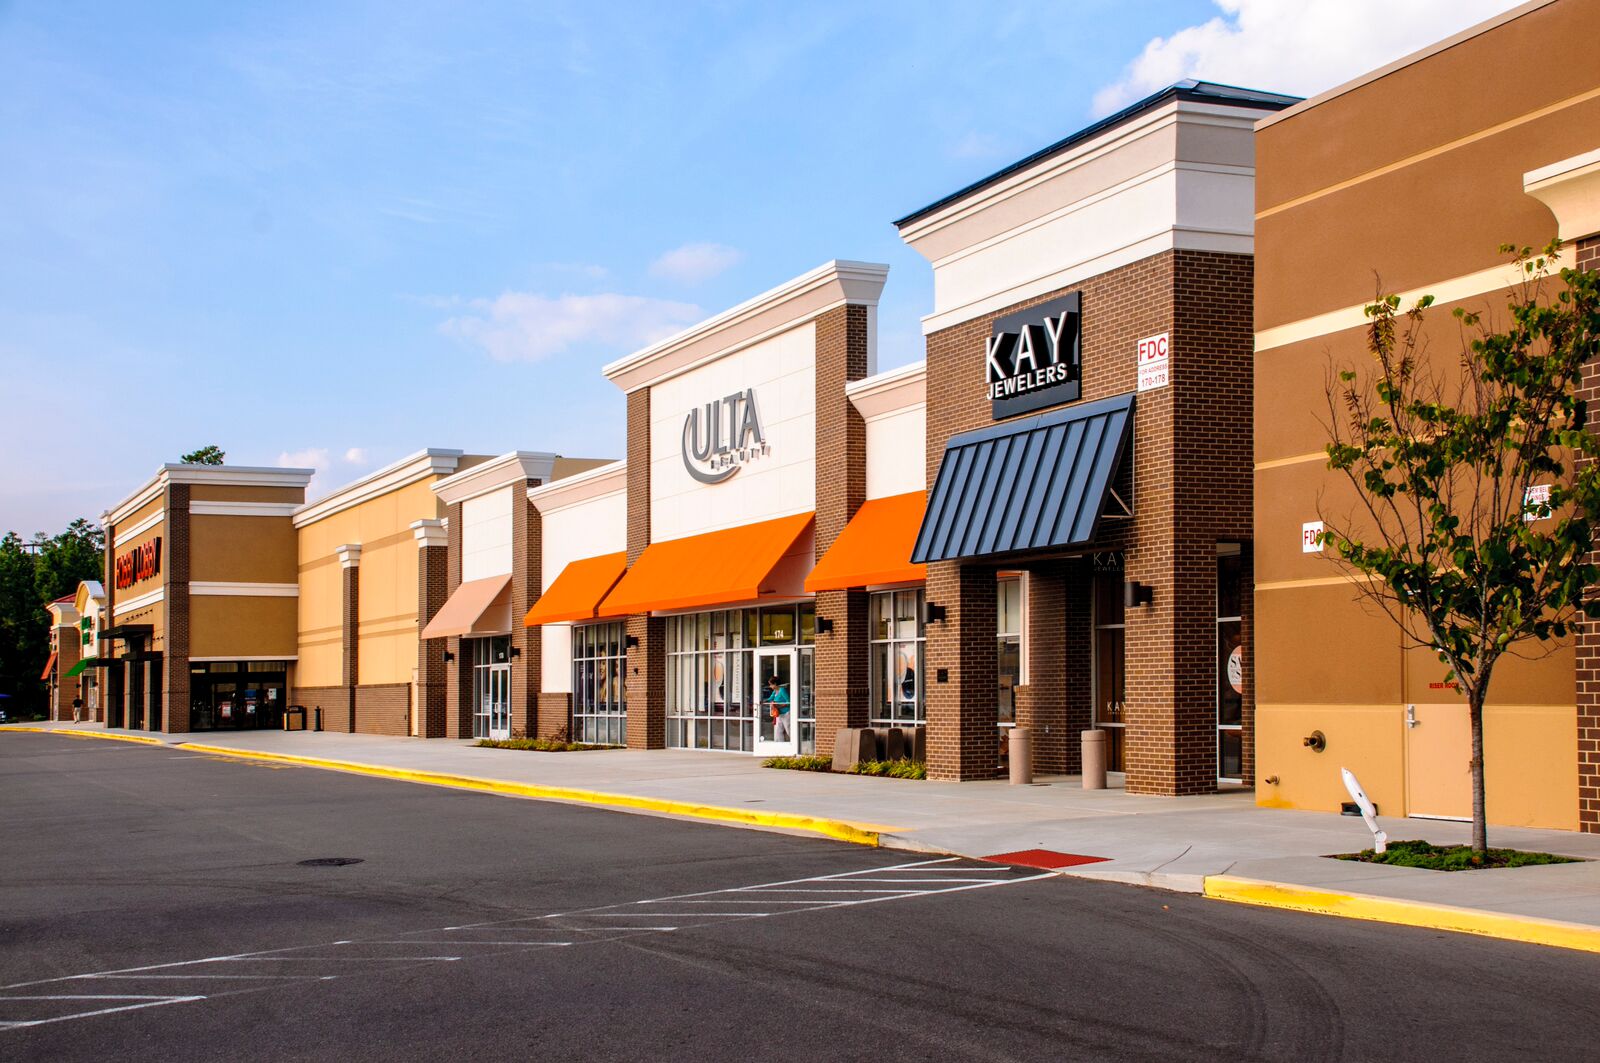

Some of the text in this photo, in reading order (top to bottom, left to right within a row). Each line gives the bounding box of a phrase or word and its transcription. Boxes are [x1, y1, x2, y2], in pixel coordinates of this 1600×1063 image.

[985, 311, 1068, 384] KAY
[1139, 337, 1167, 362] FDC
[986, 363, 1068, 400] JEWELERS
[1141, 373, 1166, 387] 170-178
[1148, 363, 1168, 373] ADDRESS
[690, 388, 761, 463] ULTA
[710, 443, 770, 470] BEAUTY
[117, 537, 160, 589] HOBBY LOBBY
[774, 630, 784, 639] 174
